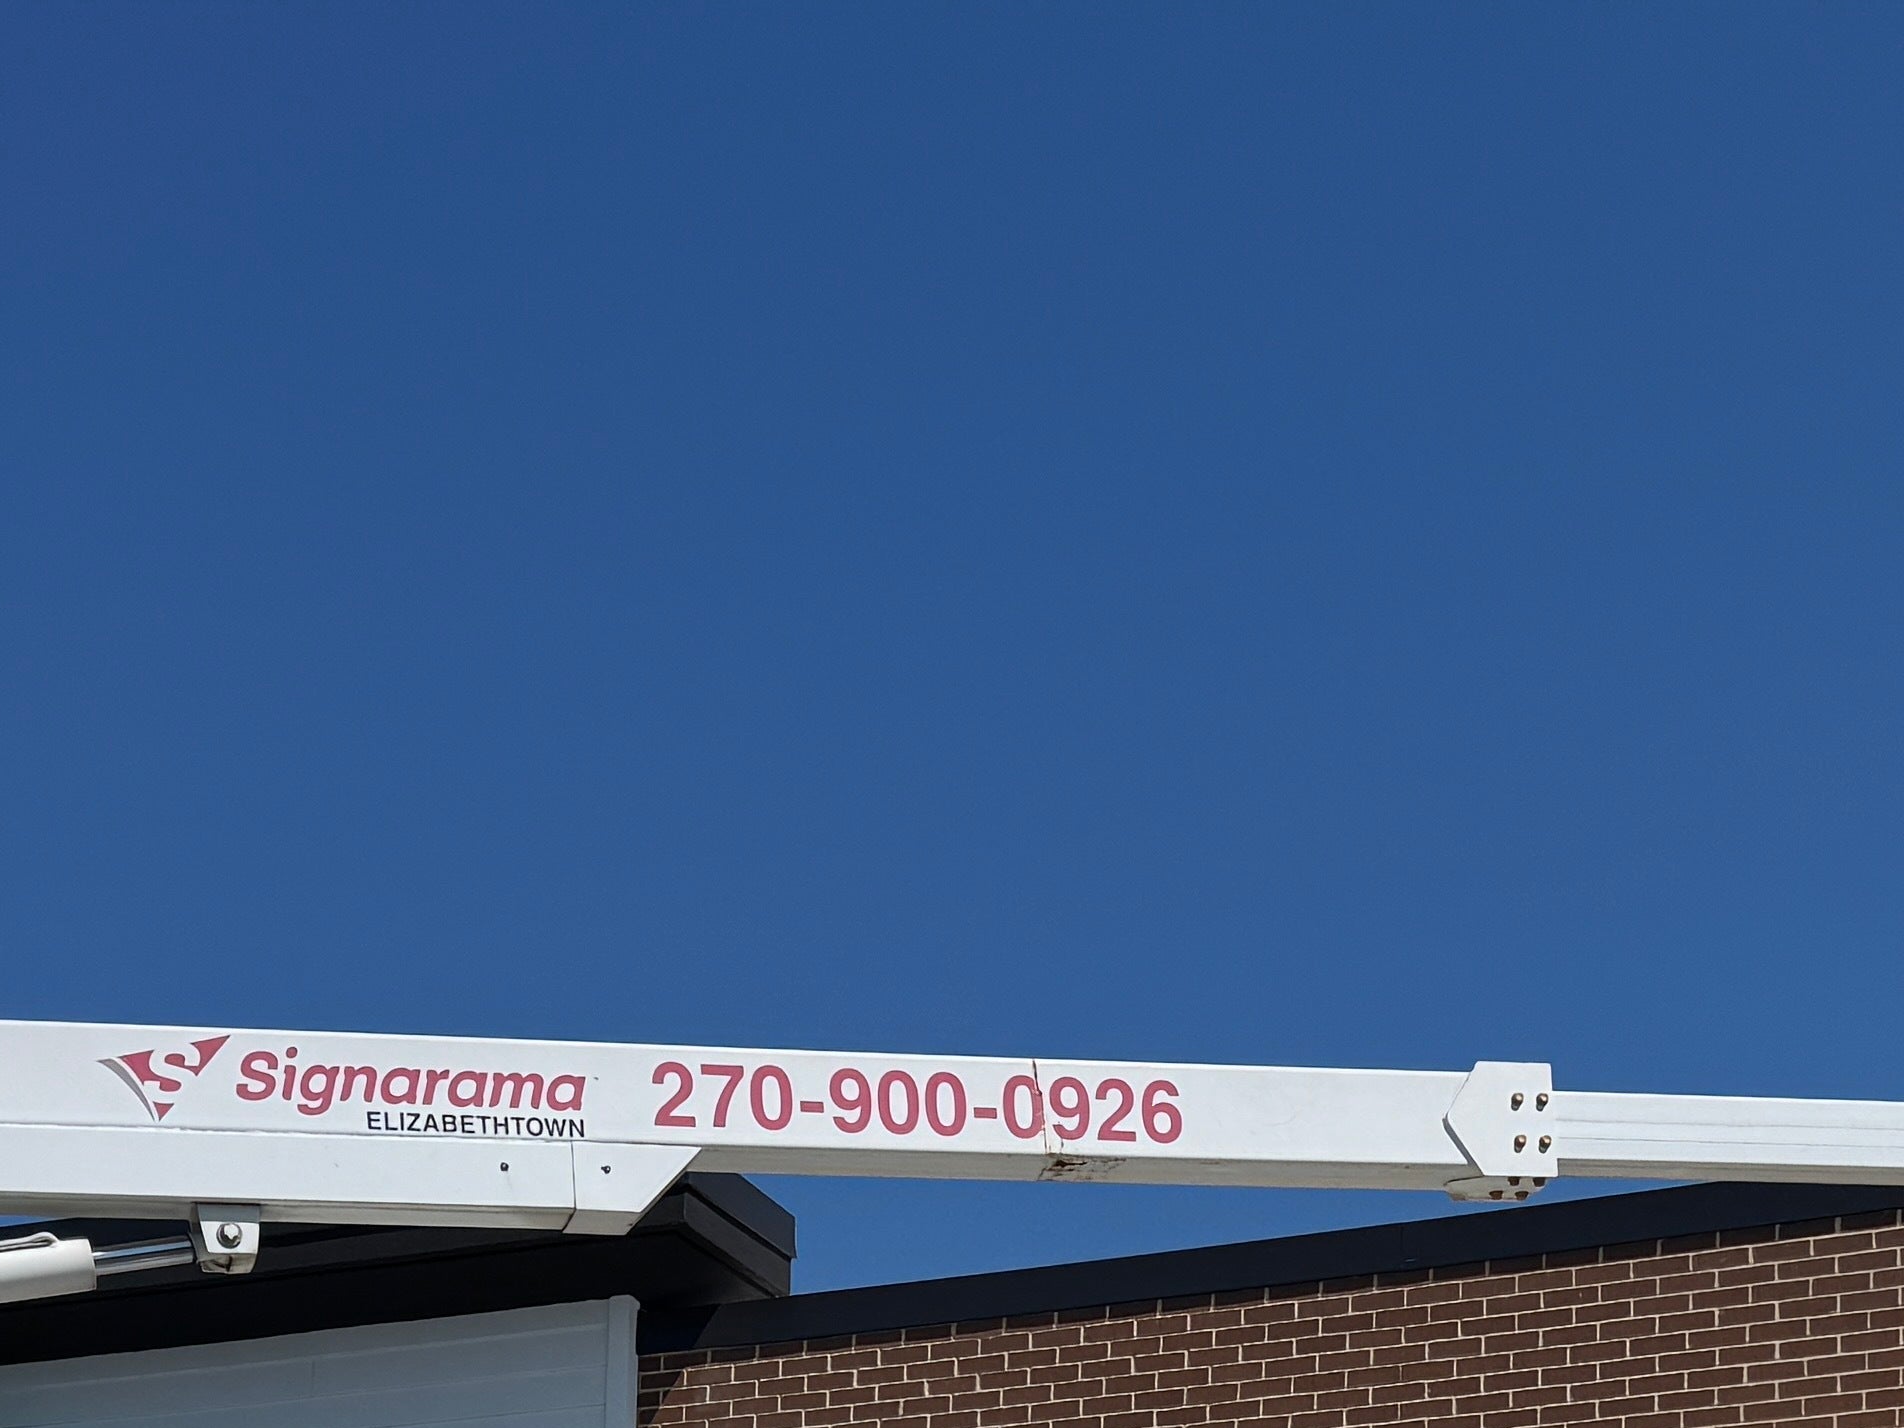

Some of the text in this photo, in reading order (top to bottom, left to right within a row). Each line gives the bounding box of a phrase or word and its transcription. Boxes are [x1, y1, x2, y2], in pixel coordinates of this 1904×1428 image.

[234, 1045, 586, 1117] Signarama
[651, 1059, 1184, 1145] 270-900-0926
[365, 1111, 585, 1139] ELIZABETHTOWN
